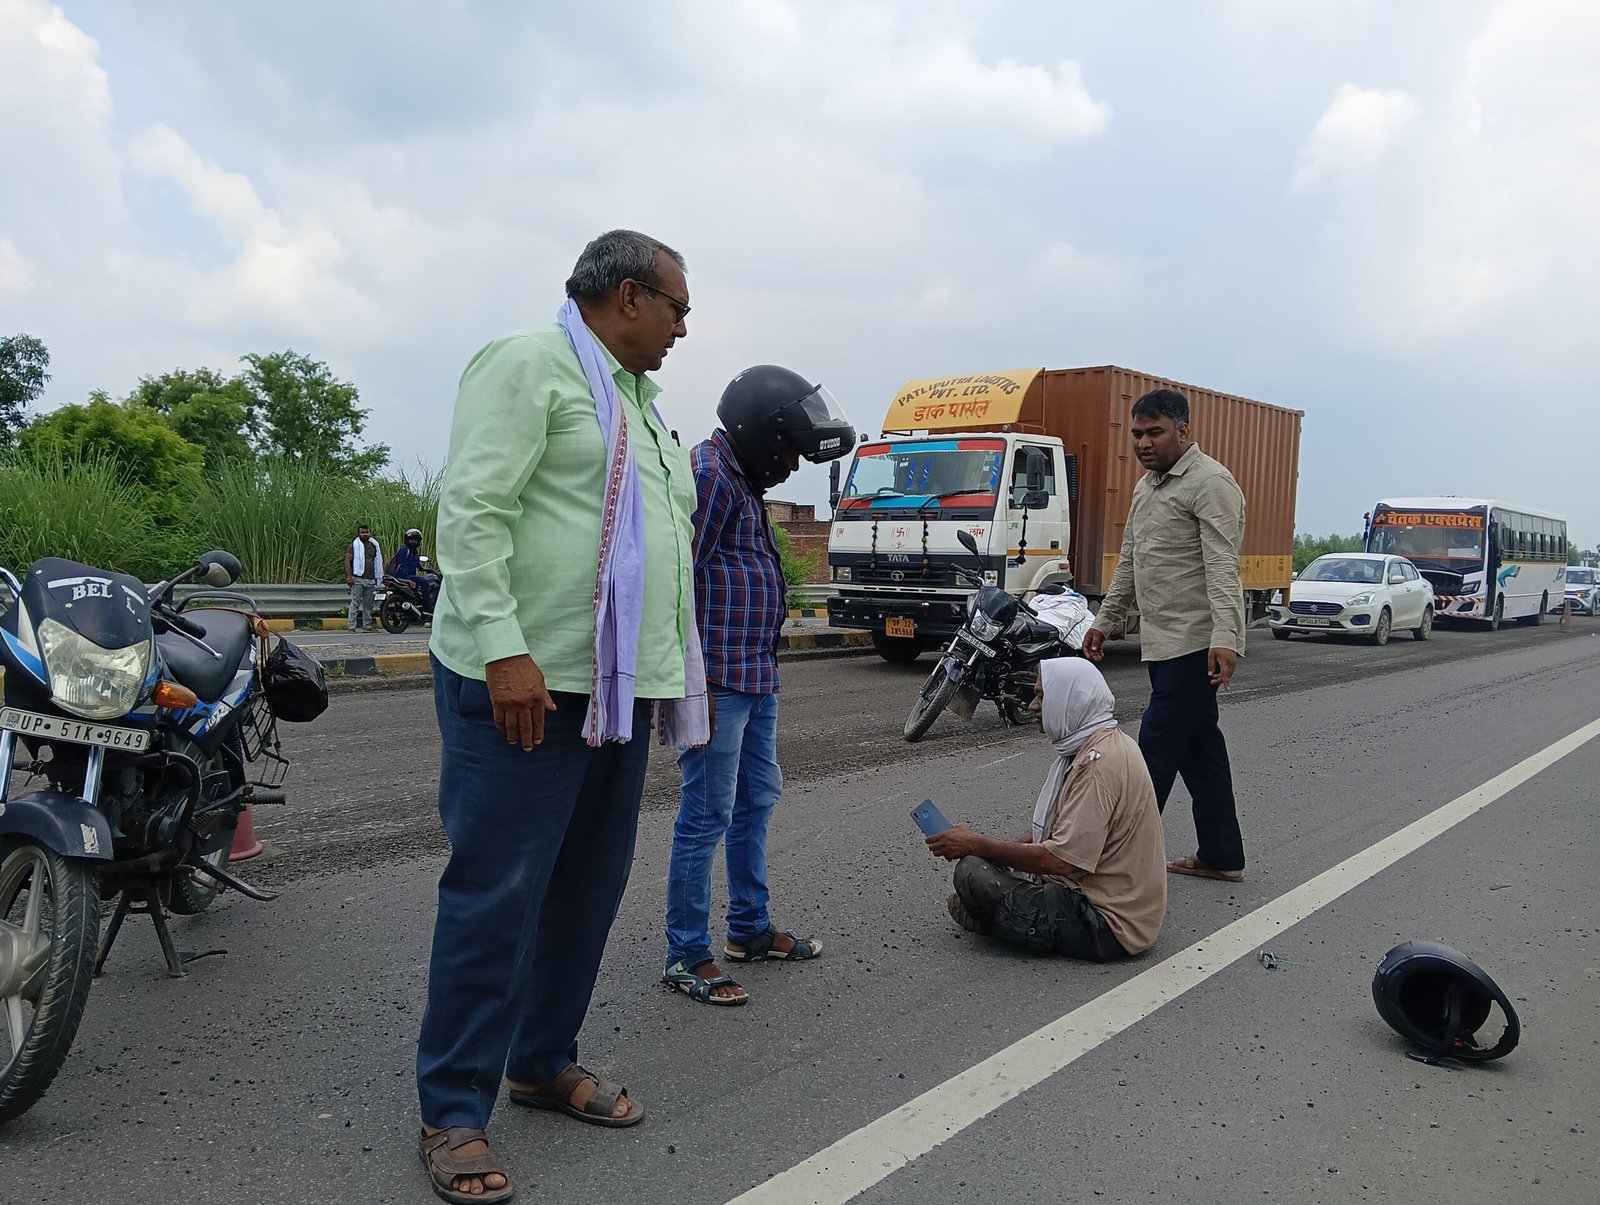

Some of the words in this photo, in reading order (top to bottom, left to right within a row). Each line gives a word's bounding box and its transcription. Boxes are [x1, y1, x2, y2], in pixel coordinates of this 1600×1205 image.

[929, 388, 958, 399] PVT.
[962, 384, 990, 397] LTD.
[974, 375, 1021, 395] LOGISTICS
[914, 404, 946, 422] डाक
[1387, 511, 1422, 525] चेतक
[1423, 512, 1483, 528] एक्सप्रेस
[887, 554, 910, 563] TATA
[21, 715, 43, 732] UP
[60, 722, 94, 741] 51K
[103, 729, 143, 748] 9649
